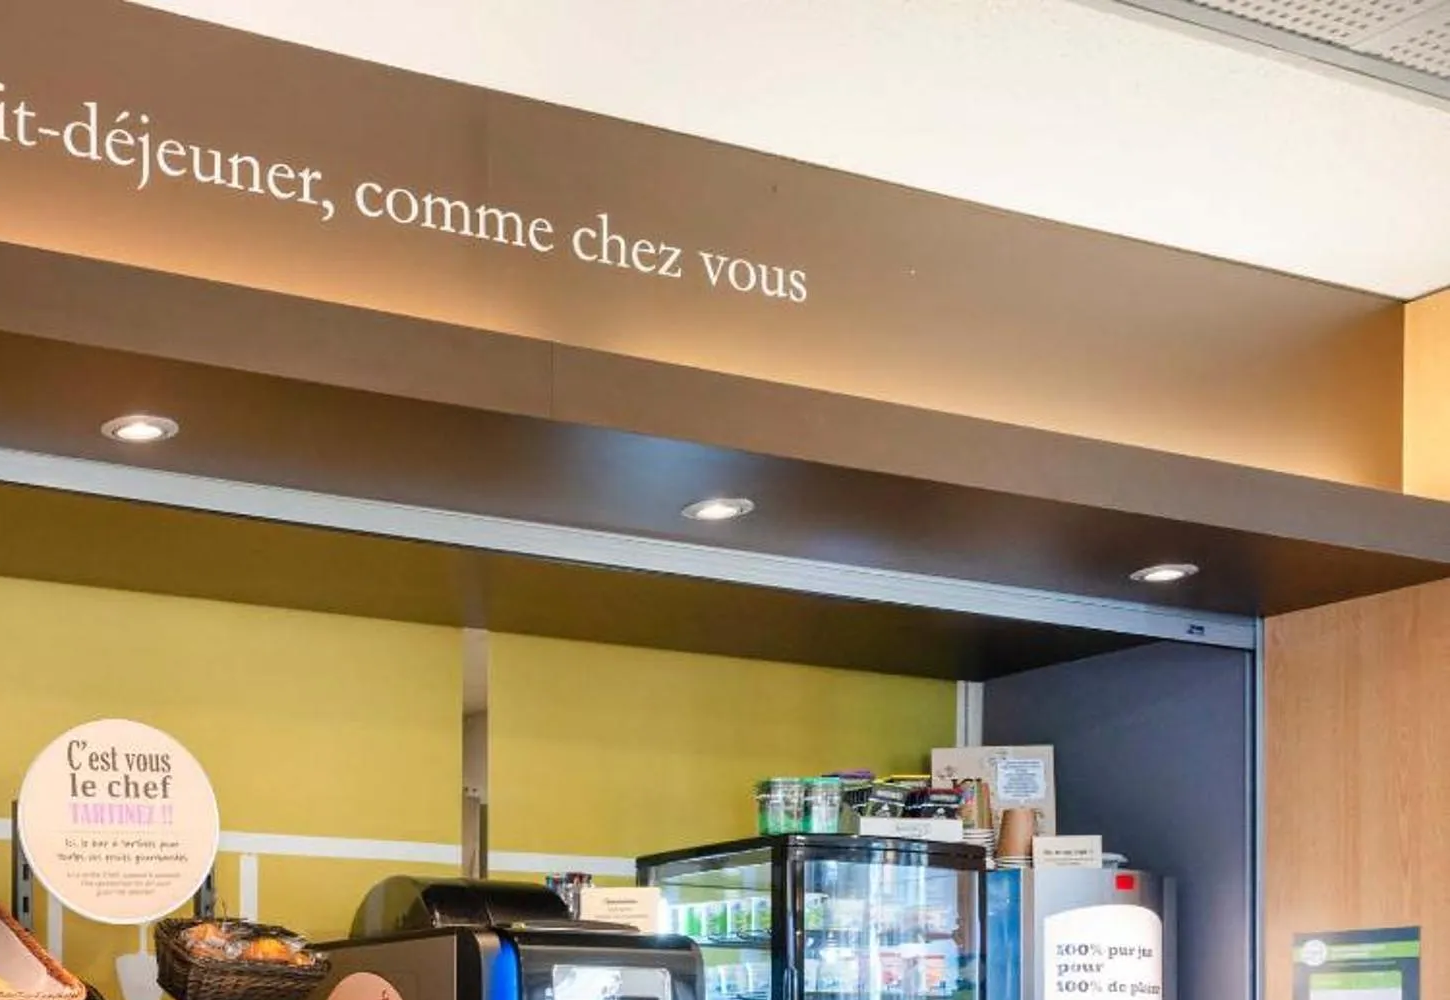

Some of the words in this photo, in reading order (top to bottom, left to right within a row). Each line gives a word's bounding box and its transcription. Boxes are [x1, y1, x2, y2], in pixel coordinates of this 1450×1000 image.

[356, 183, 553, 251] comme
[573, 214, 681, 277] chez
[700, 252, 806, 301] vous
[67, 740, 119, 772] C'est
[124, 753, 172, 773] vous
[69, 772, 97, 798] le
[107, 773, 173, 799] chef
[1056, 944, 1103, 956] 100%
[1108, 946, 1135, 959] pur
[1056, 963, 1104, 976] pour
[1056, 980, 1103, 992] 100%
[1108, 980, 1127, 993] de
